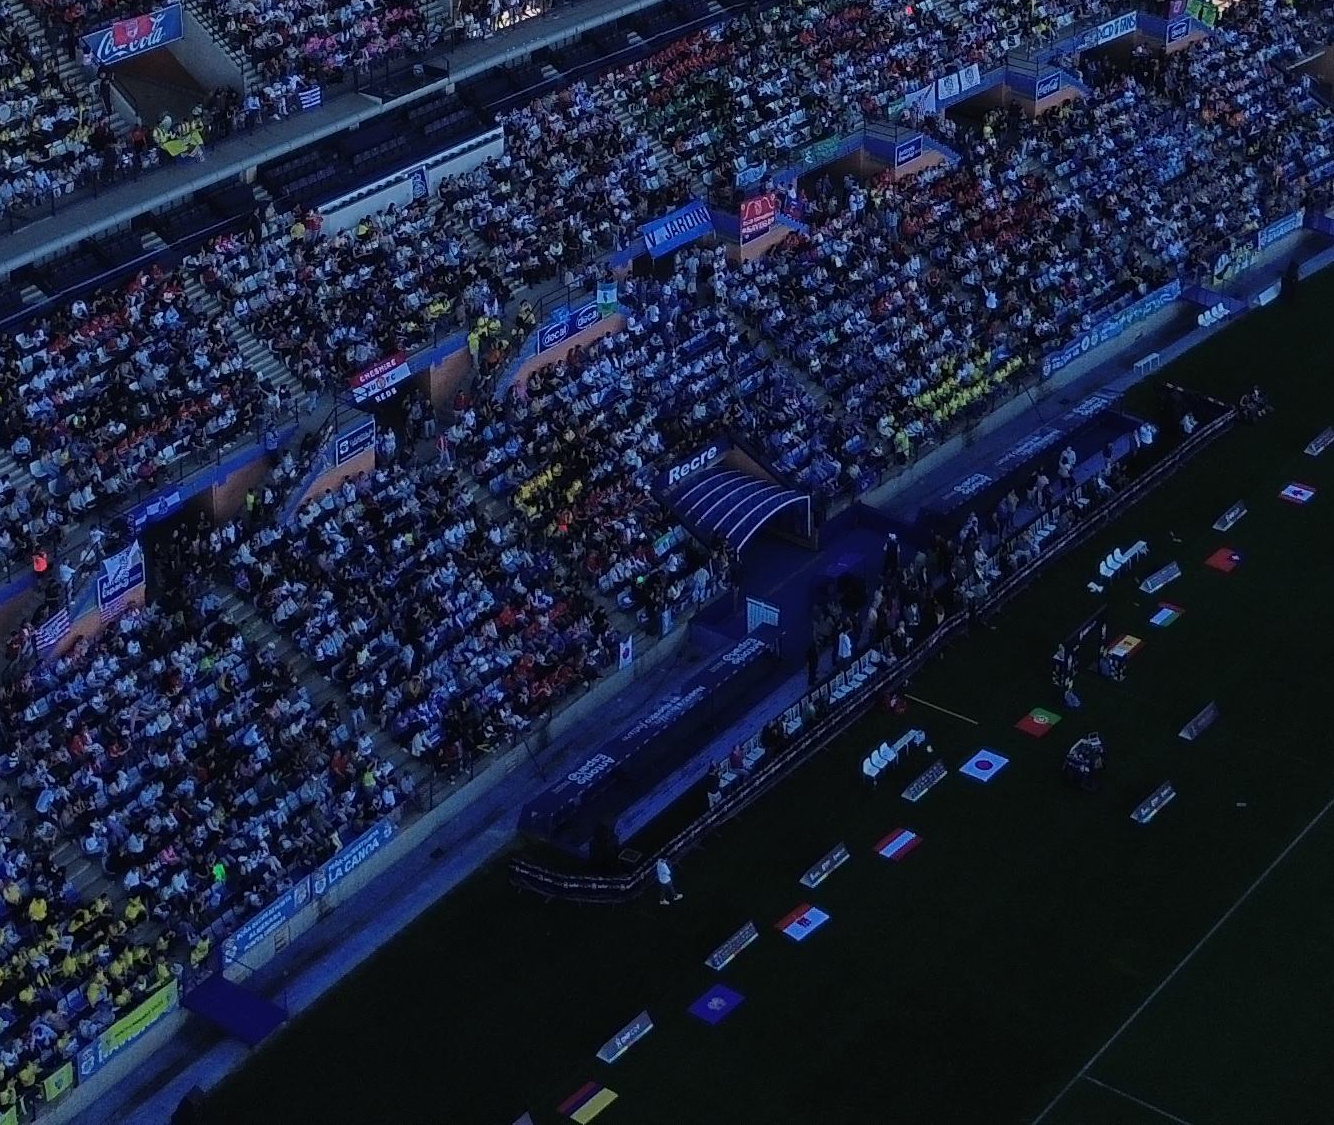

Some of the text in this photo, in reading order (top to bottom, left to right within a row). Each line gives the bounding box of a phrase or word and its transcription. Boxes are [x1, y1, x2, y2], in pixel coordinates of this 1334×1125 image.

[668, 445, 718, 485] Recre
[328, 837, 380, 884] LA CANOA
